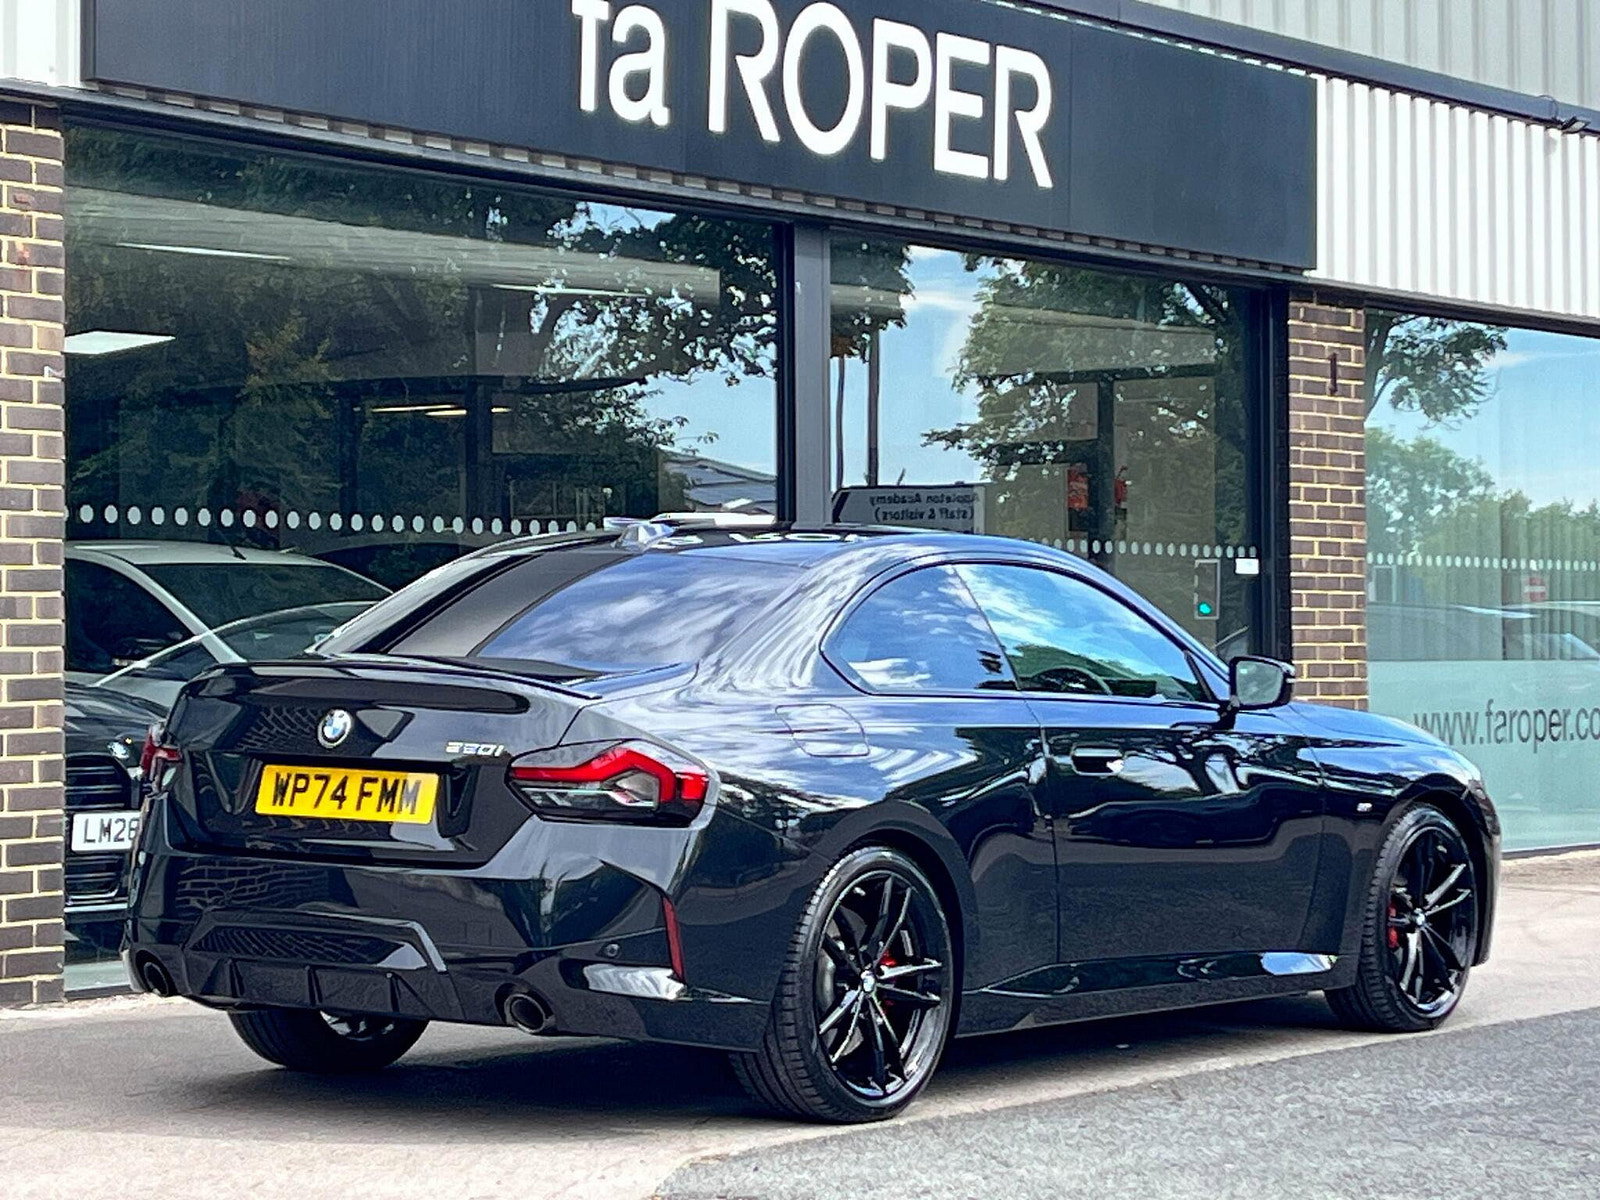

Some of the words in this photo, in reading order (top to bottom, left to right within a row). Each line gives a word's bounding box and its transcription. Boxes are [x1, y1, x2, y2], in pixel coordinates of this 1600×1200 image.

[707, 0, 1054, 189] ROPER
[271, 771, 348, 810] WP74
[355, 776, 422, 815] FMM
